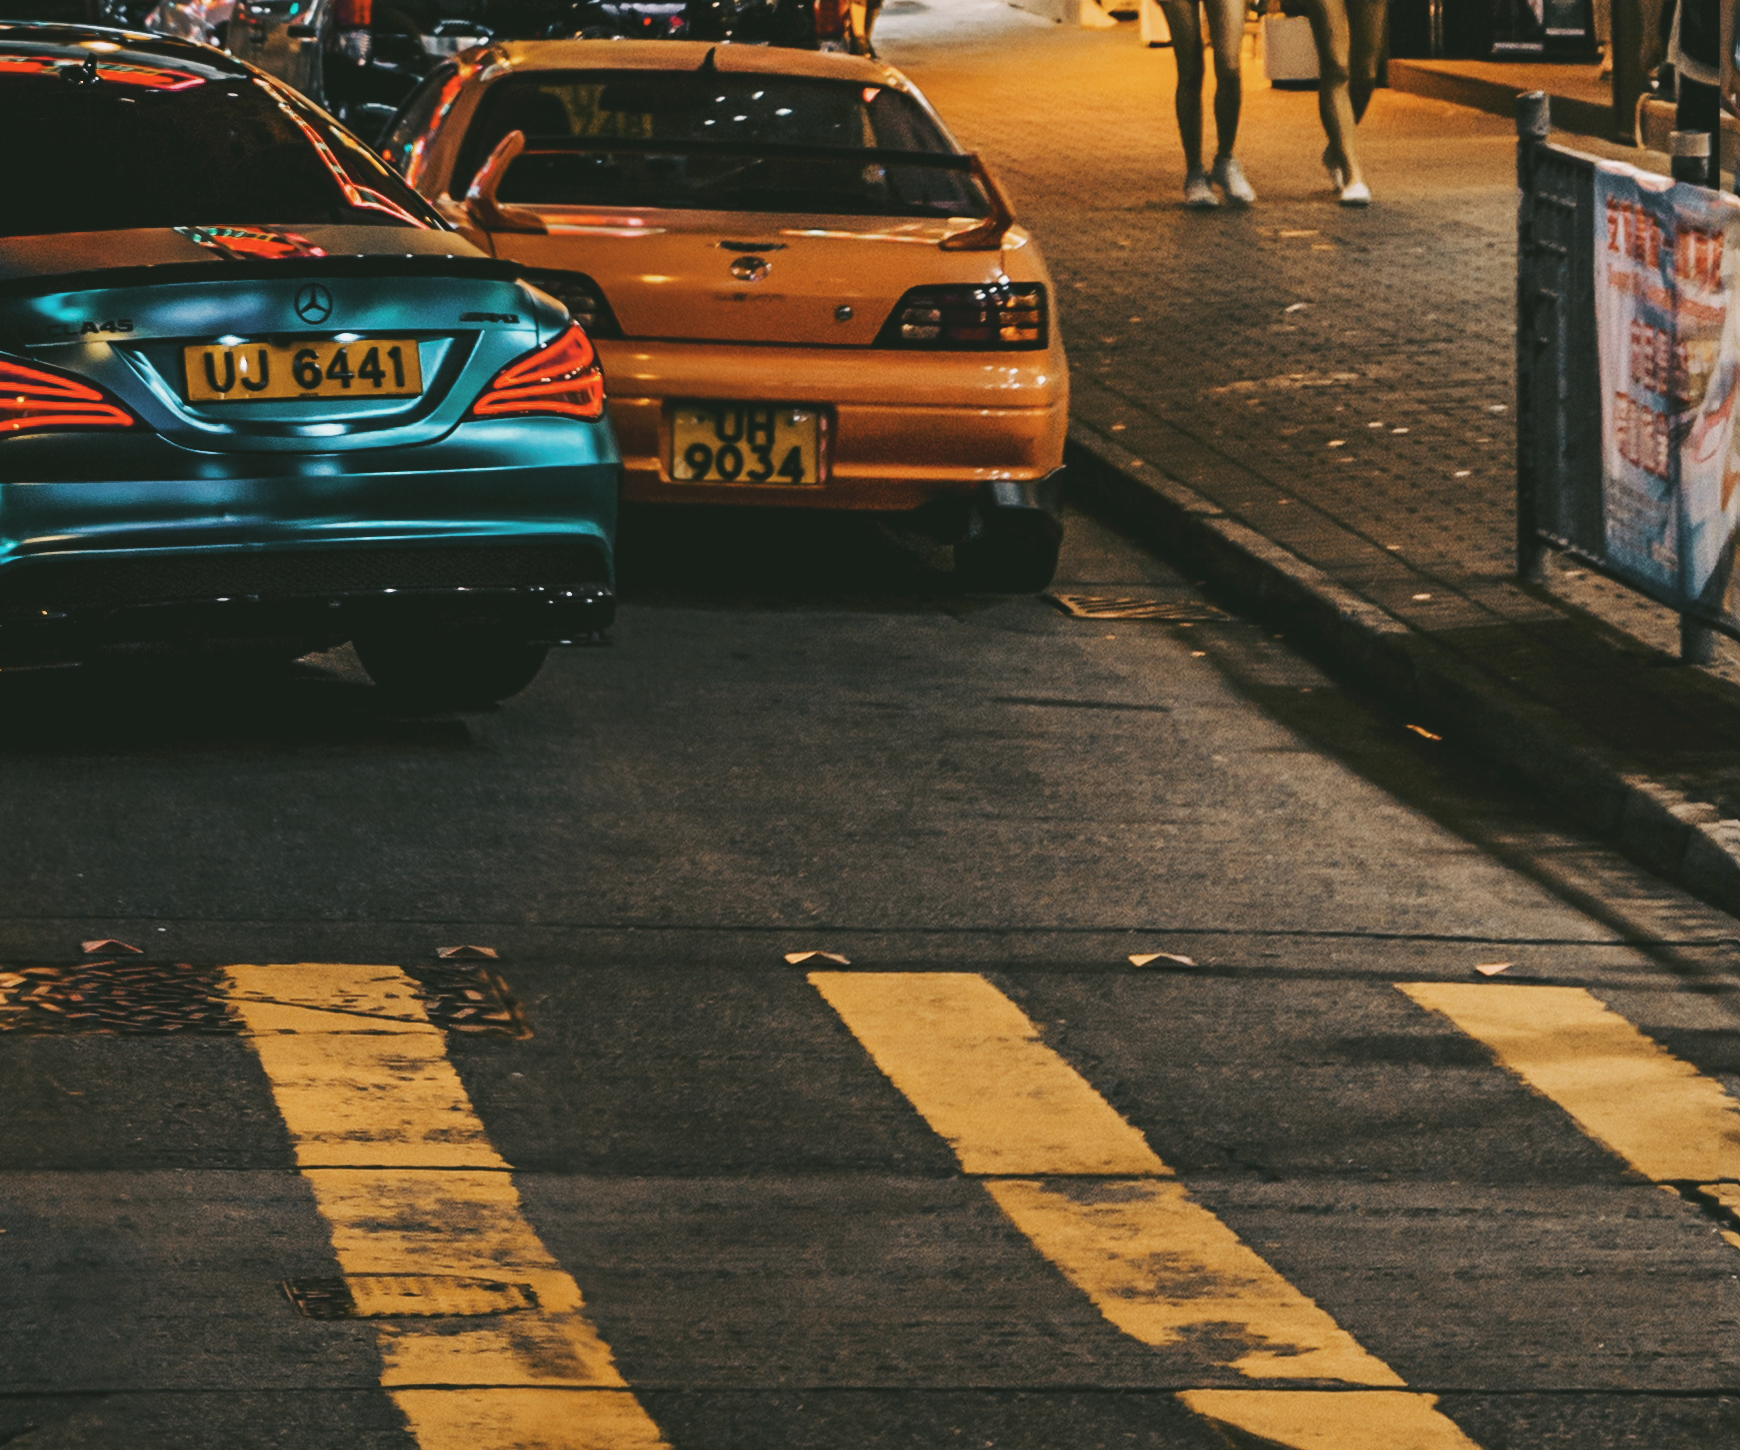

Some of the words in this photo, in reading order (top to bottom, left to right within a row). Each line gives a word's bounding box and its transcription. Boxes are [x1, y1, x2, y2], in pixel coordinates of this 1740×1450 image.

[203, 353, 273, 393] UJ
[290, 344, 405, 392] 6441
[715, 408, 776, 445] UH
[684, 443, 805, 485] 9034
